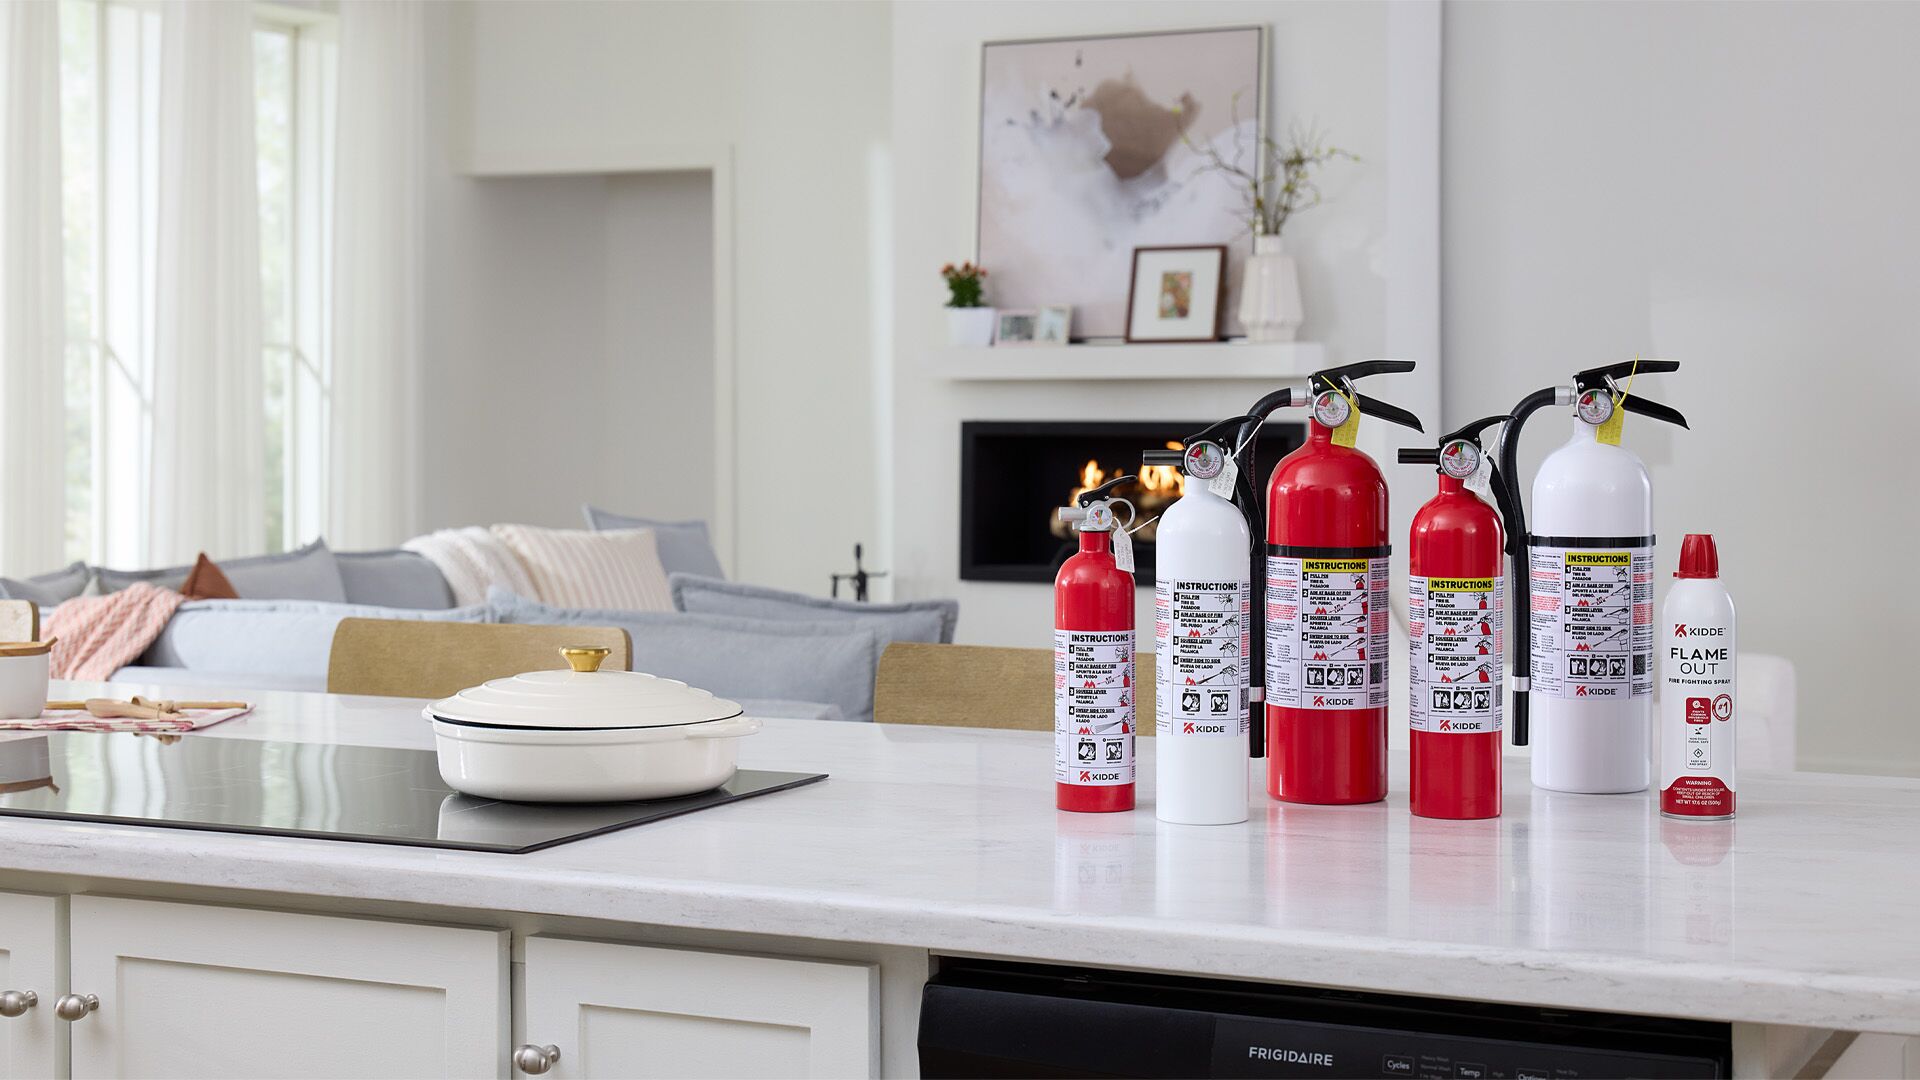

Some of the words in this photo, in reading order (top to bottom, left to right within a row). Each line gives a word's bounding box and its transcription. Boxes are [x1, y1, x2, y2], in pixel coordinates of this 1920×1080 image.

[1177, 582, 1237, 590] INSTRUCTIONS
[1690, 628, 1723, 636] KIDDE
[1072, 634, 1129, 642] INSTRUCTIONS
[1671, 648, 1728, 660] FLAME
[1681, 663, 1718, 675] OUT
[1718, 702, 1728, 713] #1
[1249, 1046, 1333, 1066] FRIGIDAIRE
[1387, 1060, 1410, 1071] Cycles
[1460, 1067, 1480, 1079] Temp
